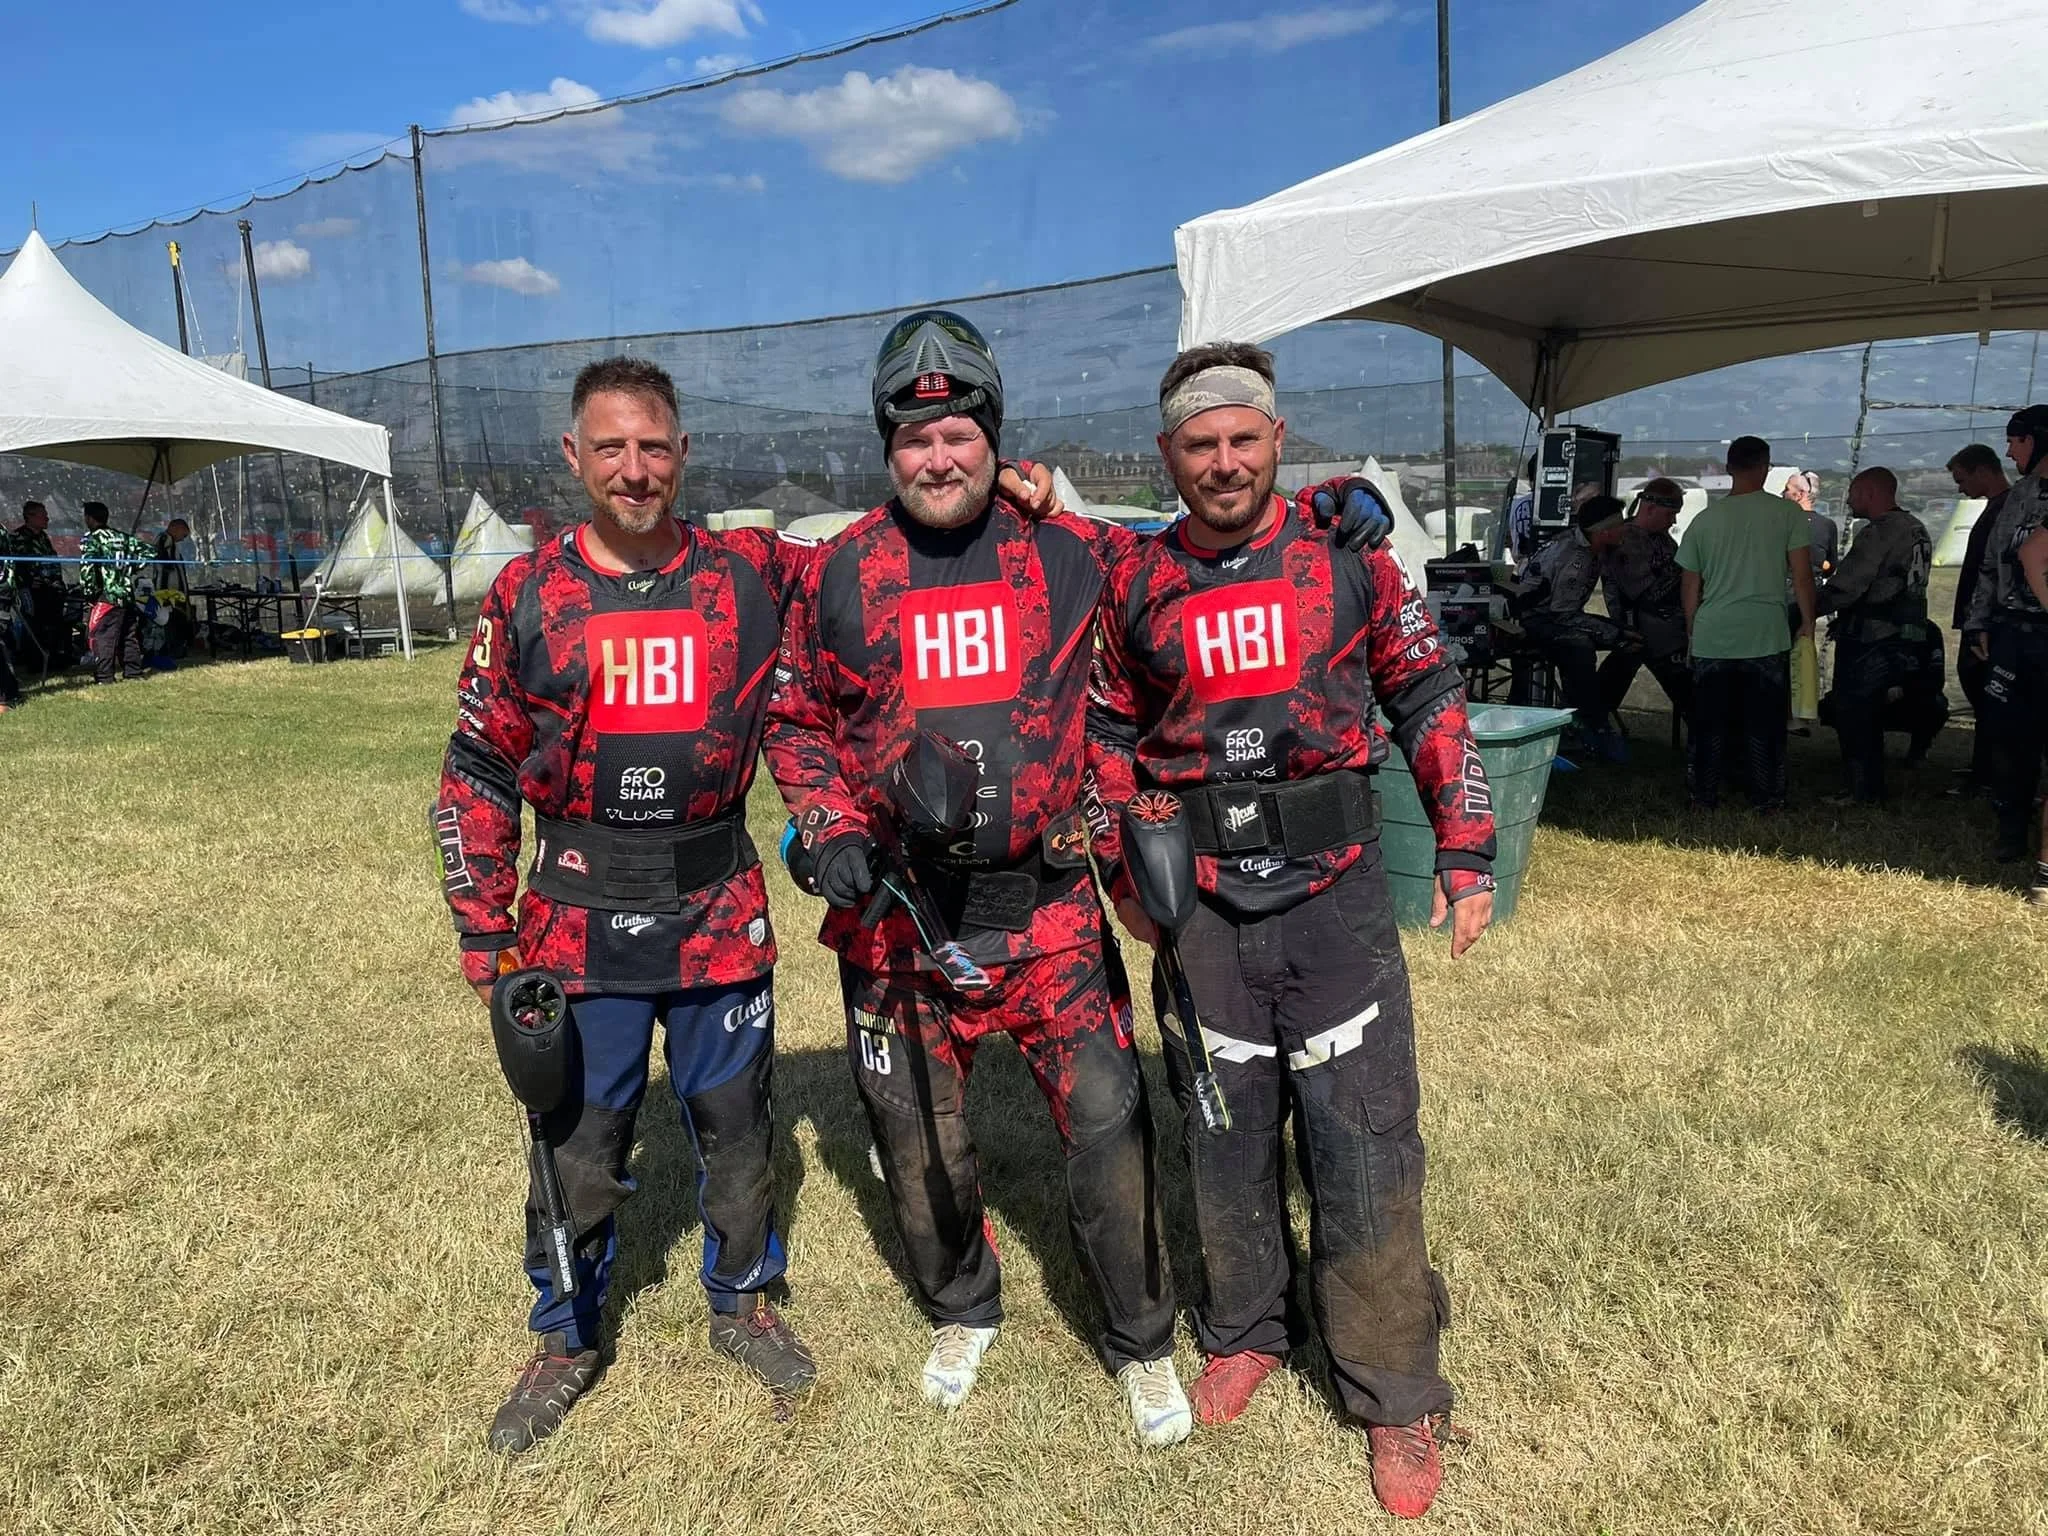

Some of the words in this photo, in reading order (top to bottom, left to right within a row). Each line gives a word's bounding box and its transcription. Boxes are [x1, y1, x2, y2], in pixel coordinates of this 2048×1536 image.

[914, 606, 1007, 680] HBI
[1196, 604, 1287, 678] HBI
[601, 636, 694, 705] HBI
[1226, 728, 1264, 749] PRO
[1226, 746, 1266, 761] SHAR
[619, 788, 665, 800] SHAR
[620, 767, 665, 788] PRO
[723, 990, 771, 1032] Anth
[860, 1029, 892, 1076] 03
